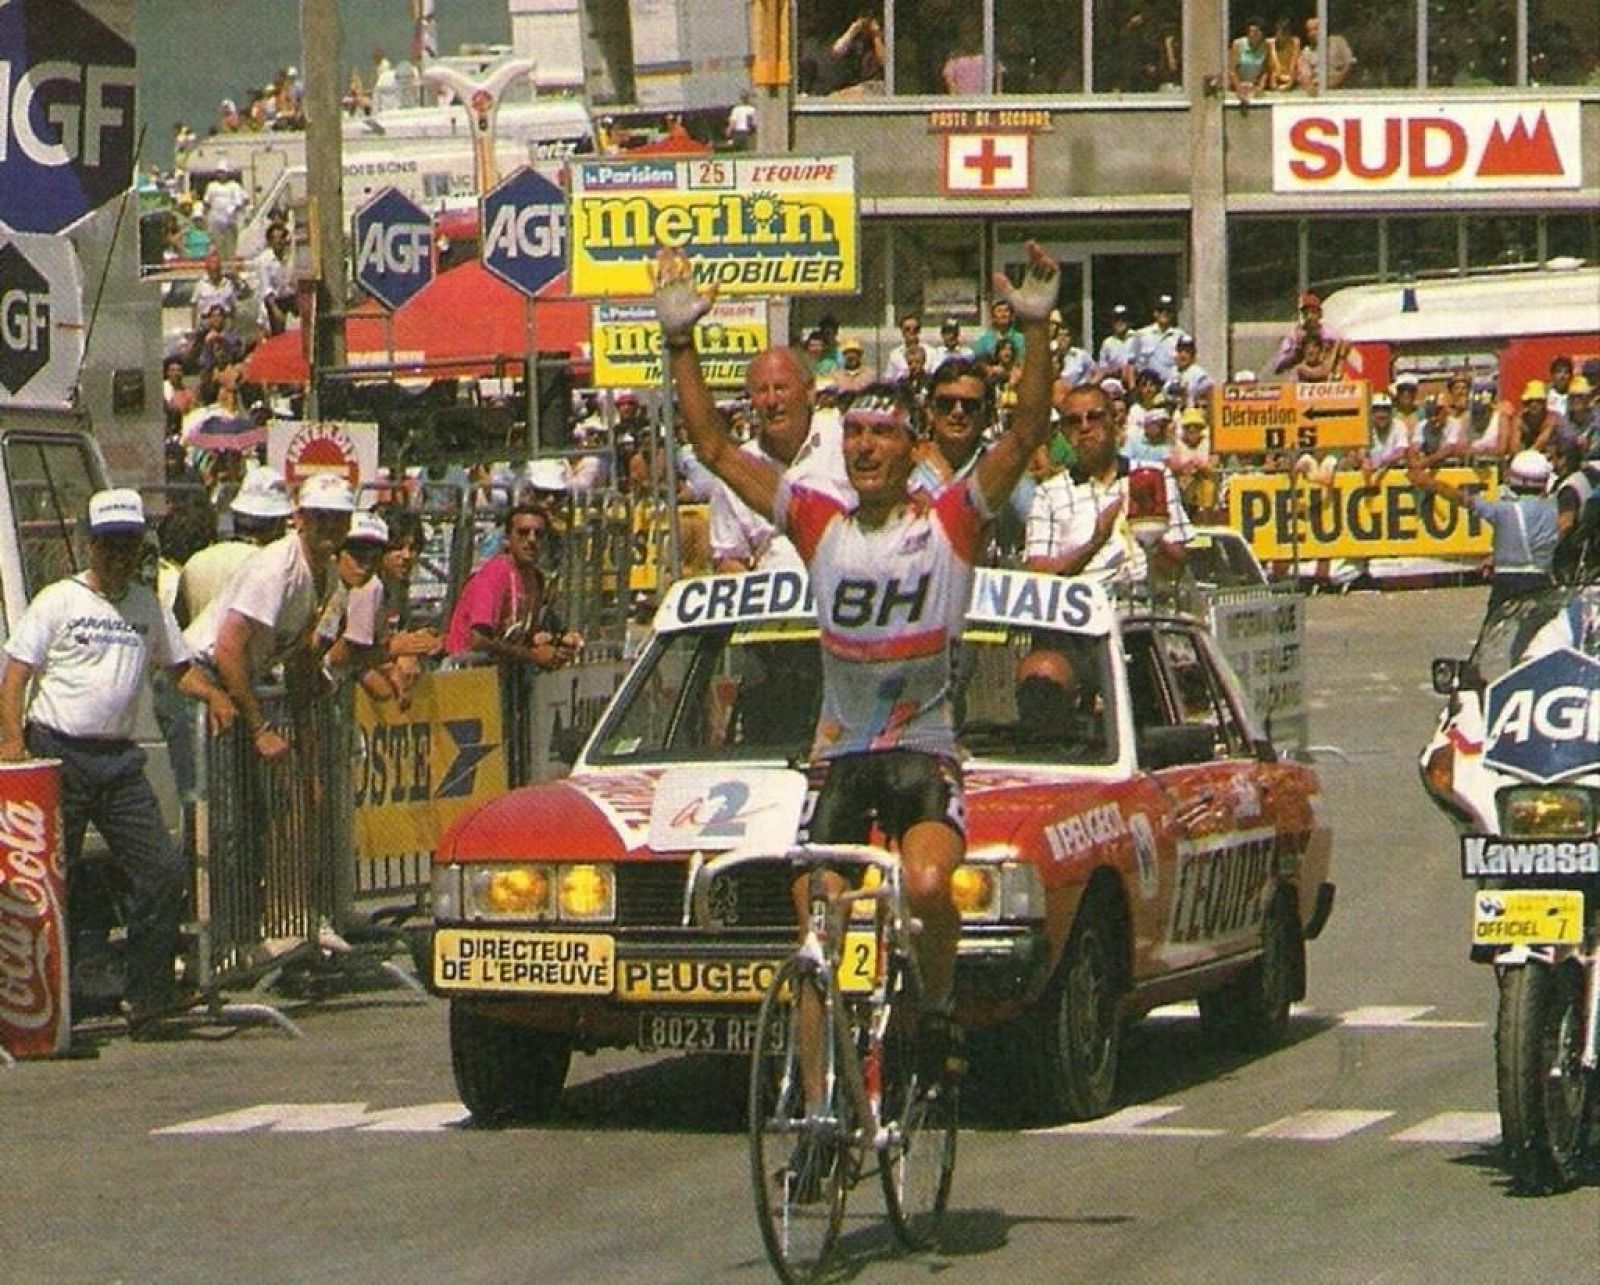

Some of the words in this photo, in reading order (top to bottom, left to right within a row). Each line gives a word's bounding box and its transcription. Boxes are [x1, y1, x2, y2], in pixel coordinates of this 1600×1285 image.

[0, 59, 136, 166] GF
[1288, 117, 1468, 180] SUD
[599, 166, 674, 184] Parisien
[700, 163, 727, 184] 25
[583, 189, 836, 248] merlin
[358, 221, 429, 273] AGF
[693, 259, 844, 285] MOBILIER
[1240, 481, 1489, 544] PEUGEOT
[676, 571, 814, 623] CREDI
[972, 573, 1093, 628] NAIS
[832, 573, 931, 628] BH
[353, 721, 431, 807] OSTE
[1476, 920, 1539, 937] OFFICIEL
[459, 938, 588, 963] DIRECTEUR
[854, 943, 870, 976] 2
[443, 960, 471, 981] DE
[483, 961, 608, 986] L'EPREUVE
[652, 1015, 715, 1048] 8023
[771, 1020, 786, 1050] 9
